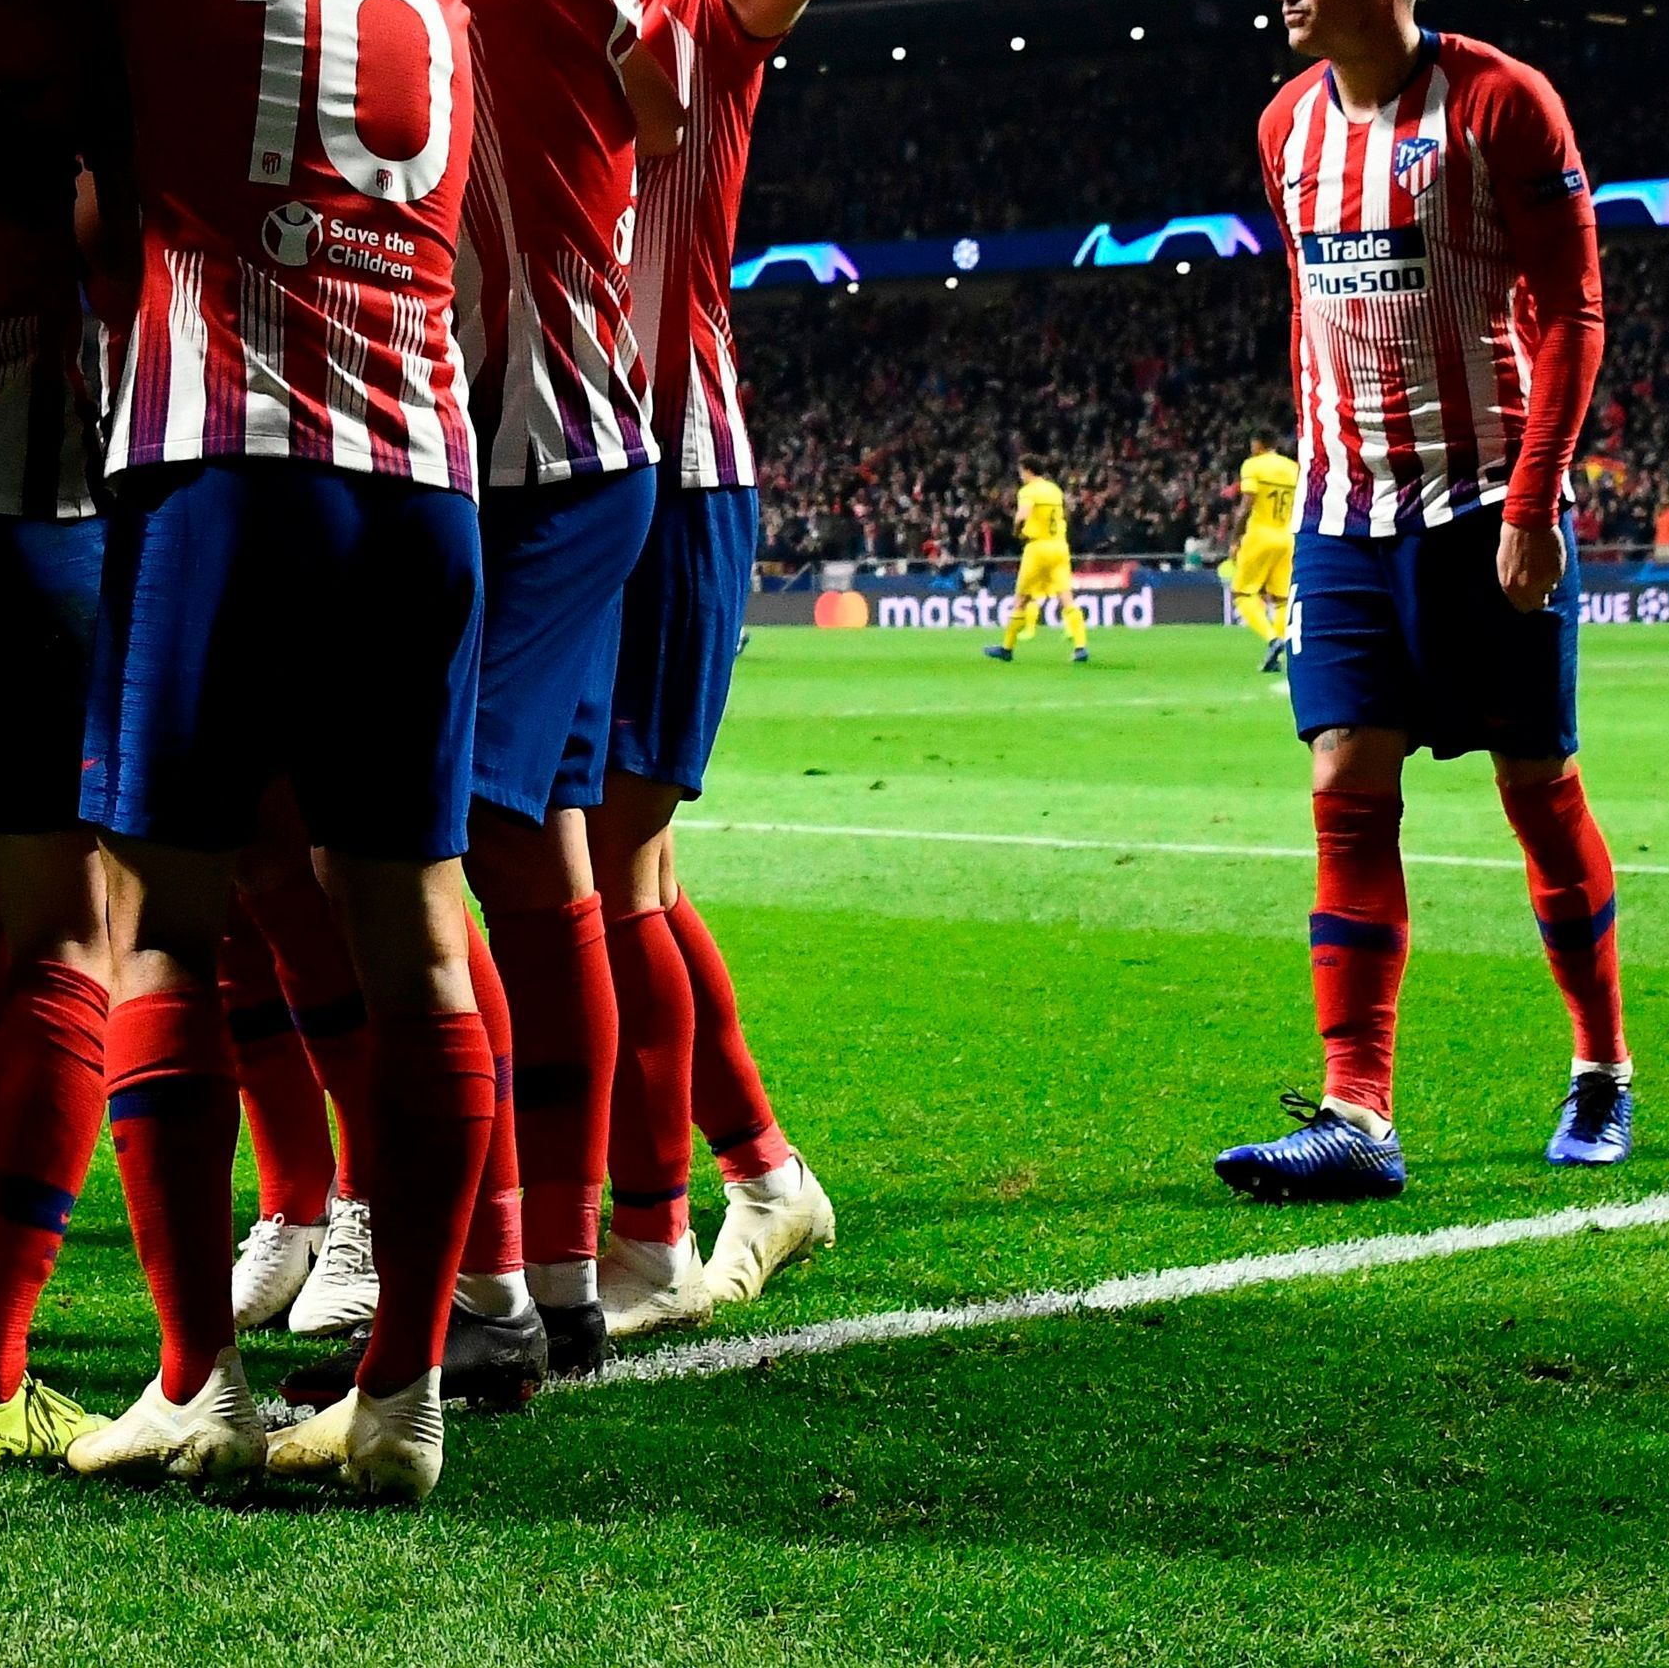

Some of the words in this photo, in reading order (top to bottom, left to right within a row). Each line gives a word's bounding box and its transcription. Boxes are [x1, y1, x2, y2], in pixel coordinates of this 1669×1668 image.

[329, 218, 379, 246] Save
[384, 232, 416, 256] the
[1316, 232, 1392, 263] Trade
[327, 244, 414, 281] Children
[1307, 266, 1427, 296] Plus500
